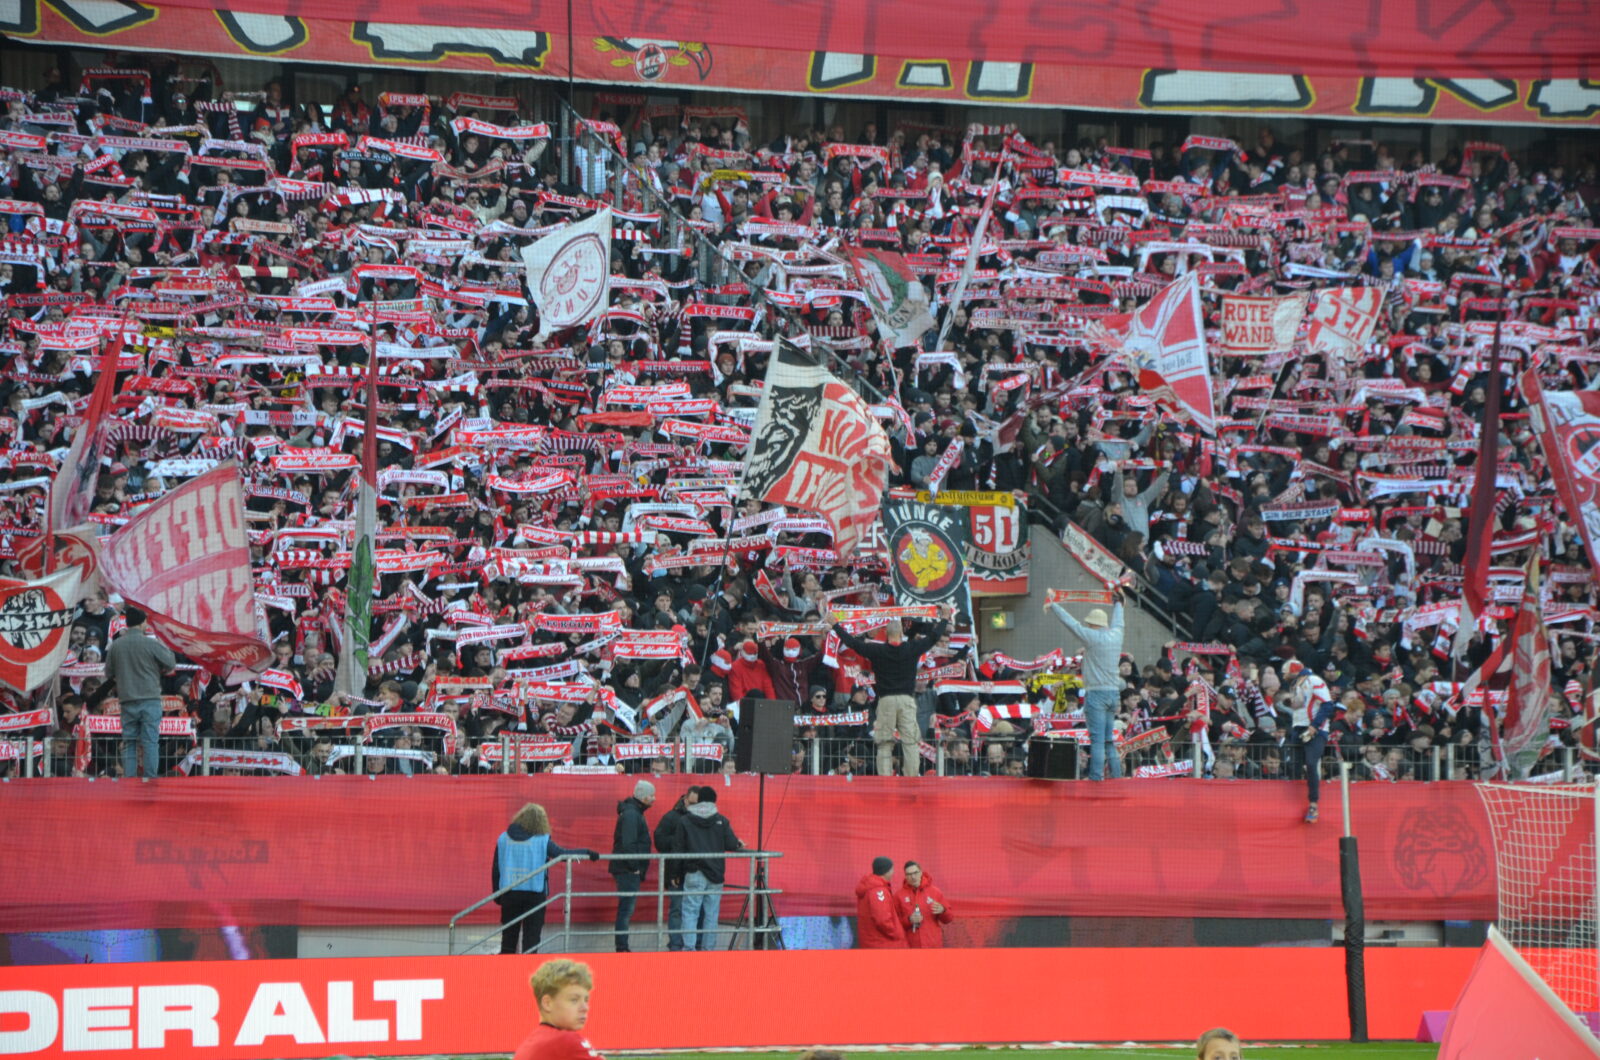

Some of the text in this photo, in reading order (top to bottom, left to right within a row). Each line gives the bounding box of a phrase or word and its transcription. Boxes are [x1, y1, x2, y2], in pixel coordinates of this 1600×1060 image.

[1224, 303, 1270, 322] ROTE
[1223, 325, 1273, 344] WAND
[889, 503, 954, 532] JUNGE
[975, 514, 1014, 546] 51
[974, 548, 992, 565] FC
[89, 717, 187, 732] MSTAD NDIKAT
[0, 979, 444, 1055] DER ALT
